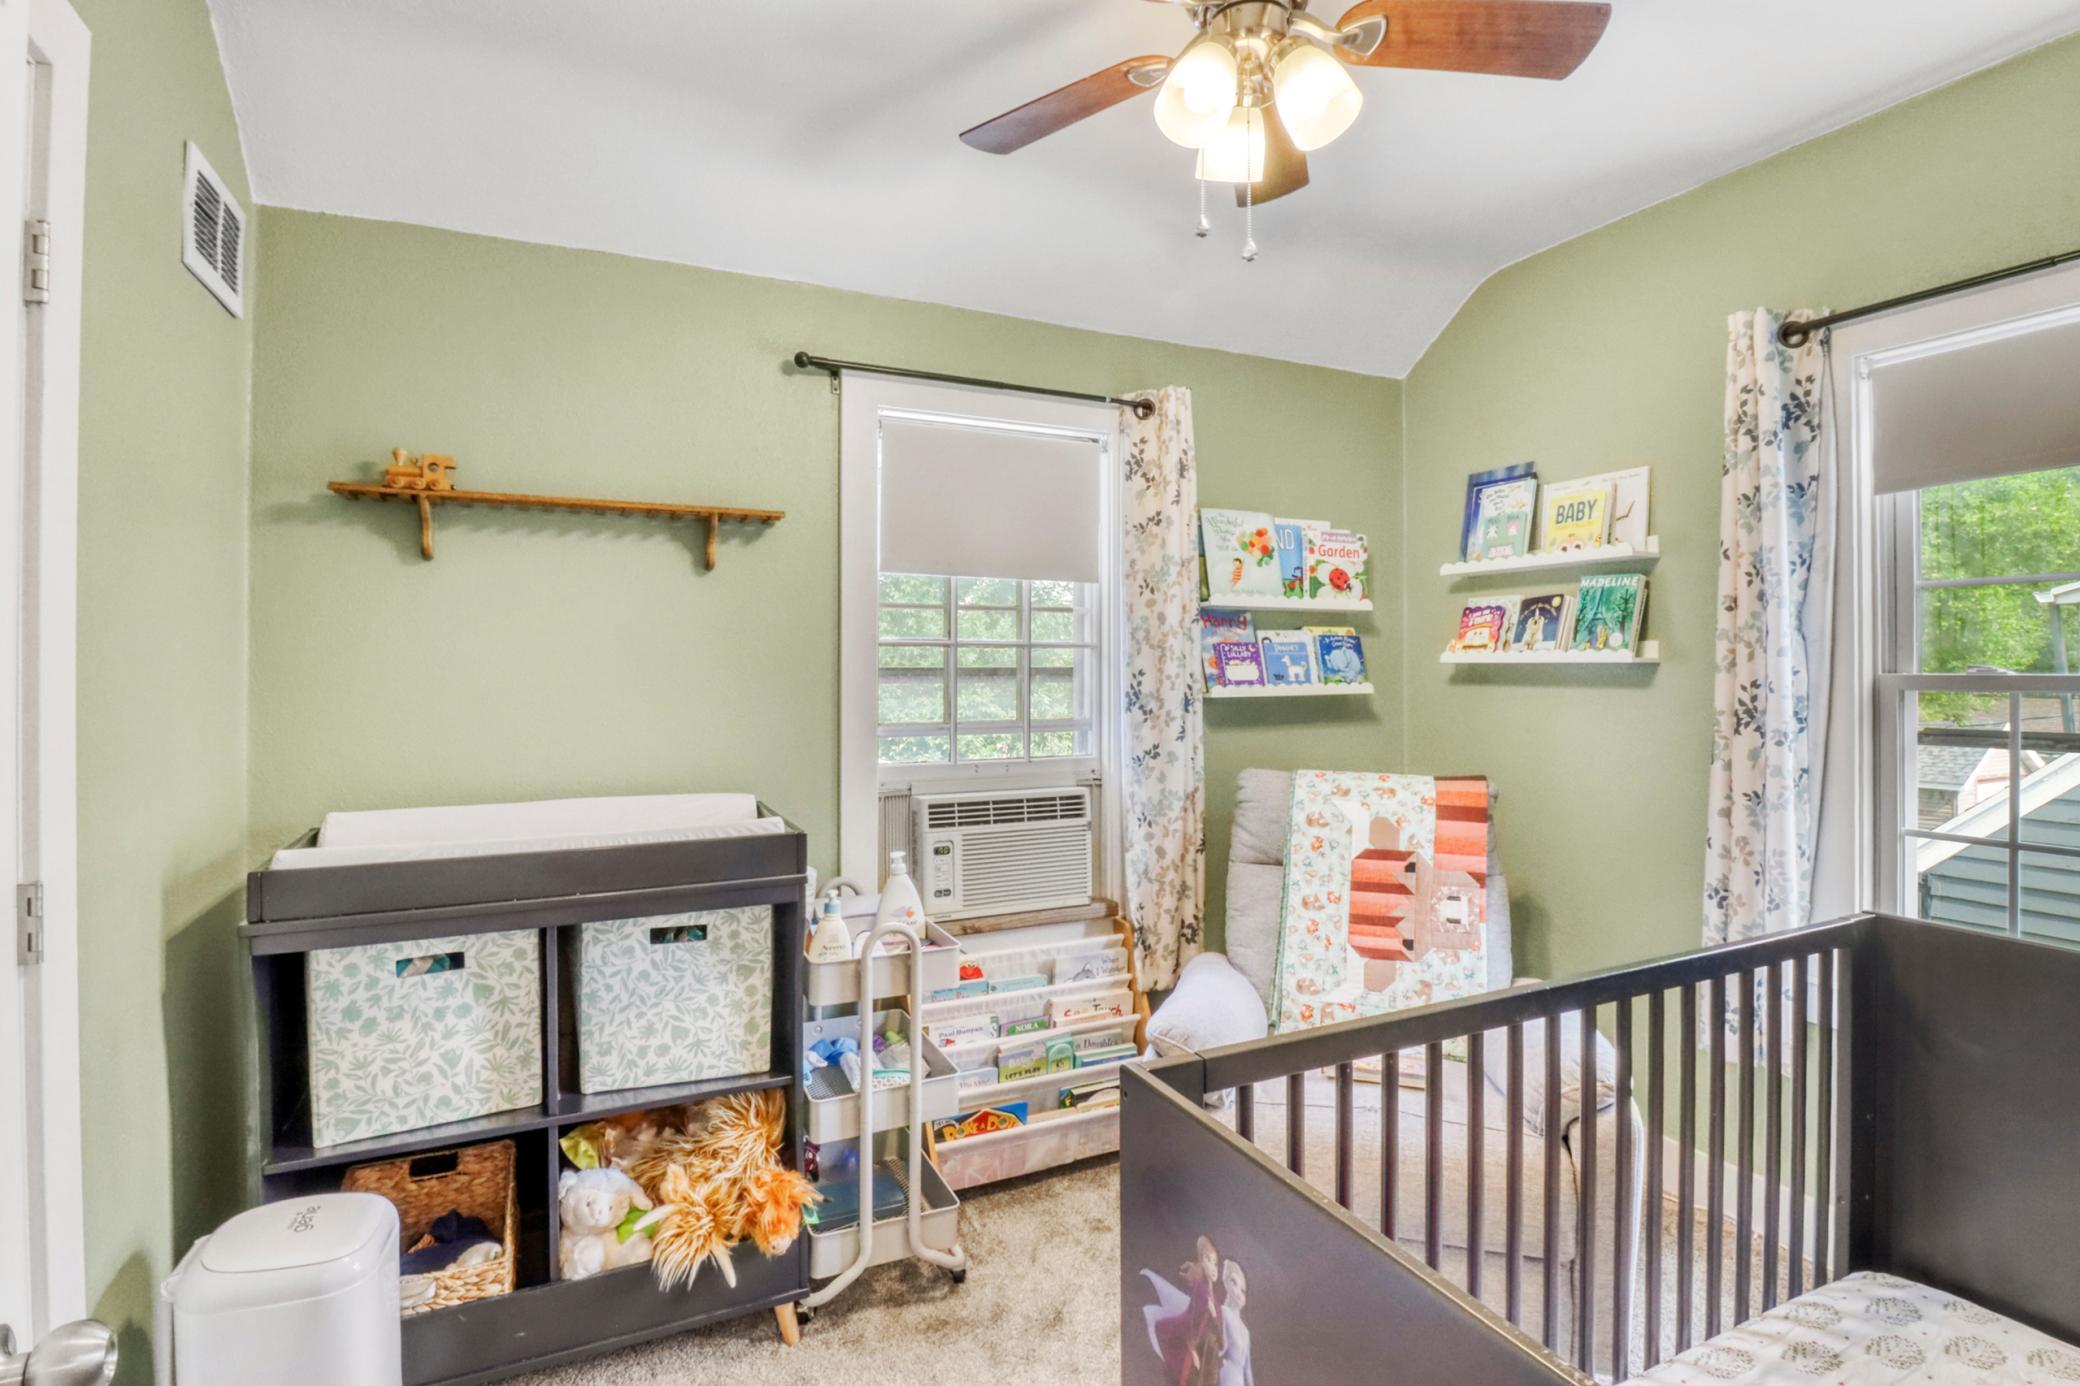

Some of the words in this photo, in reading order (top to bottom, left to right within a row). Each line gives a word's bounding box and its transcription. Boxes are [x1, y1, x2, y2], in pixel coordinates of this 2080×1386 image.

[1555, 499, 1597, 525] BABY
[1318, 544, 1360, 559] Garden
[1580, 575, 1640, 588] MADELINE
[938, 1030, 956, 1039] Paul
[956, 1025, 984, 1036] Bunyan
[1015, 1021, 1039, 1034] NORA
